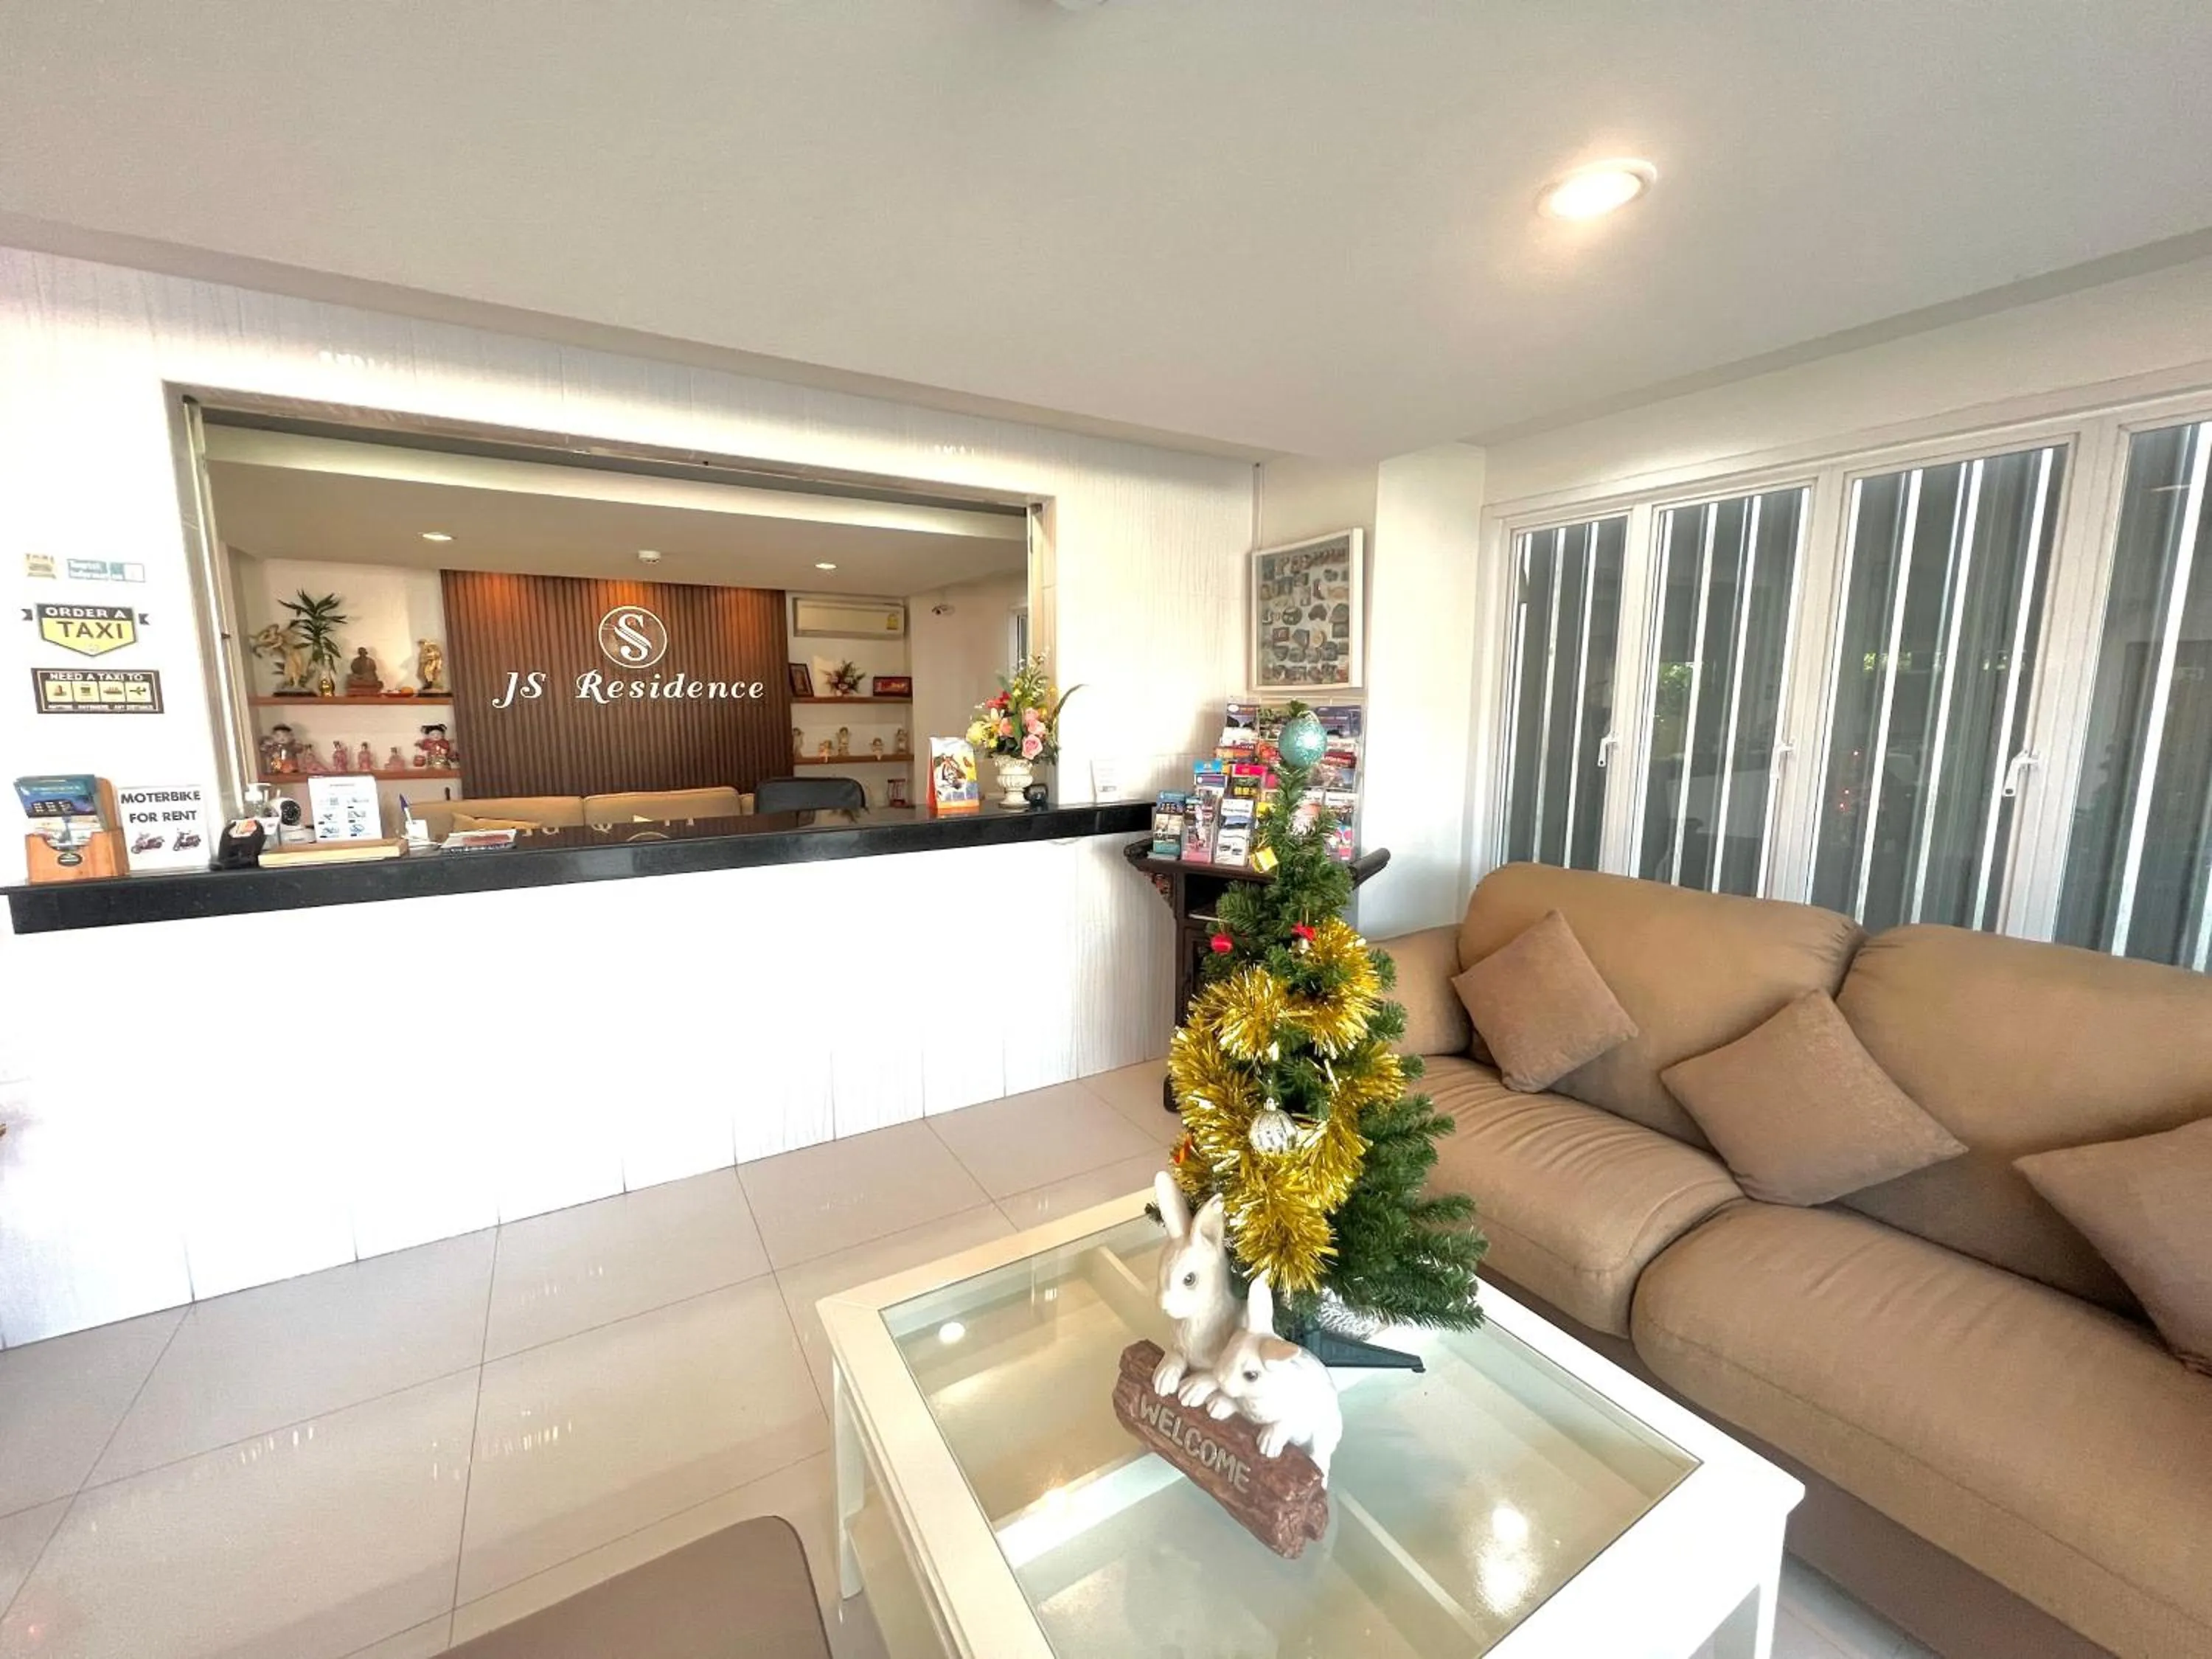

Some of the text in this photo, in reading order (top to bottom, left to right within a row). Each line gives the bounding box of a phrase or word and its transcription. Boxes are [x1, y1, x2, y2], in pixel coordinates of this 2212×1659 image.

[45, 607, 126, 619] ORDER A
[56, 621, 124, 639] TAXI
[50, 672, 83, 681] NEED
[99, 672, 124, 681] TAXI
[492, 668, 764, 709] JS Residence
[120, 790, 201, 804] MOTERBIKE
[129, 810, 198, 824] FOR RENT
[1140, 1394, 1252, 1494] WELCOME
